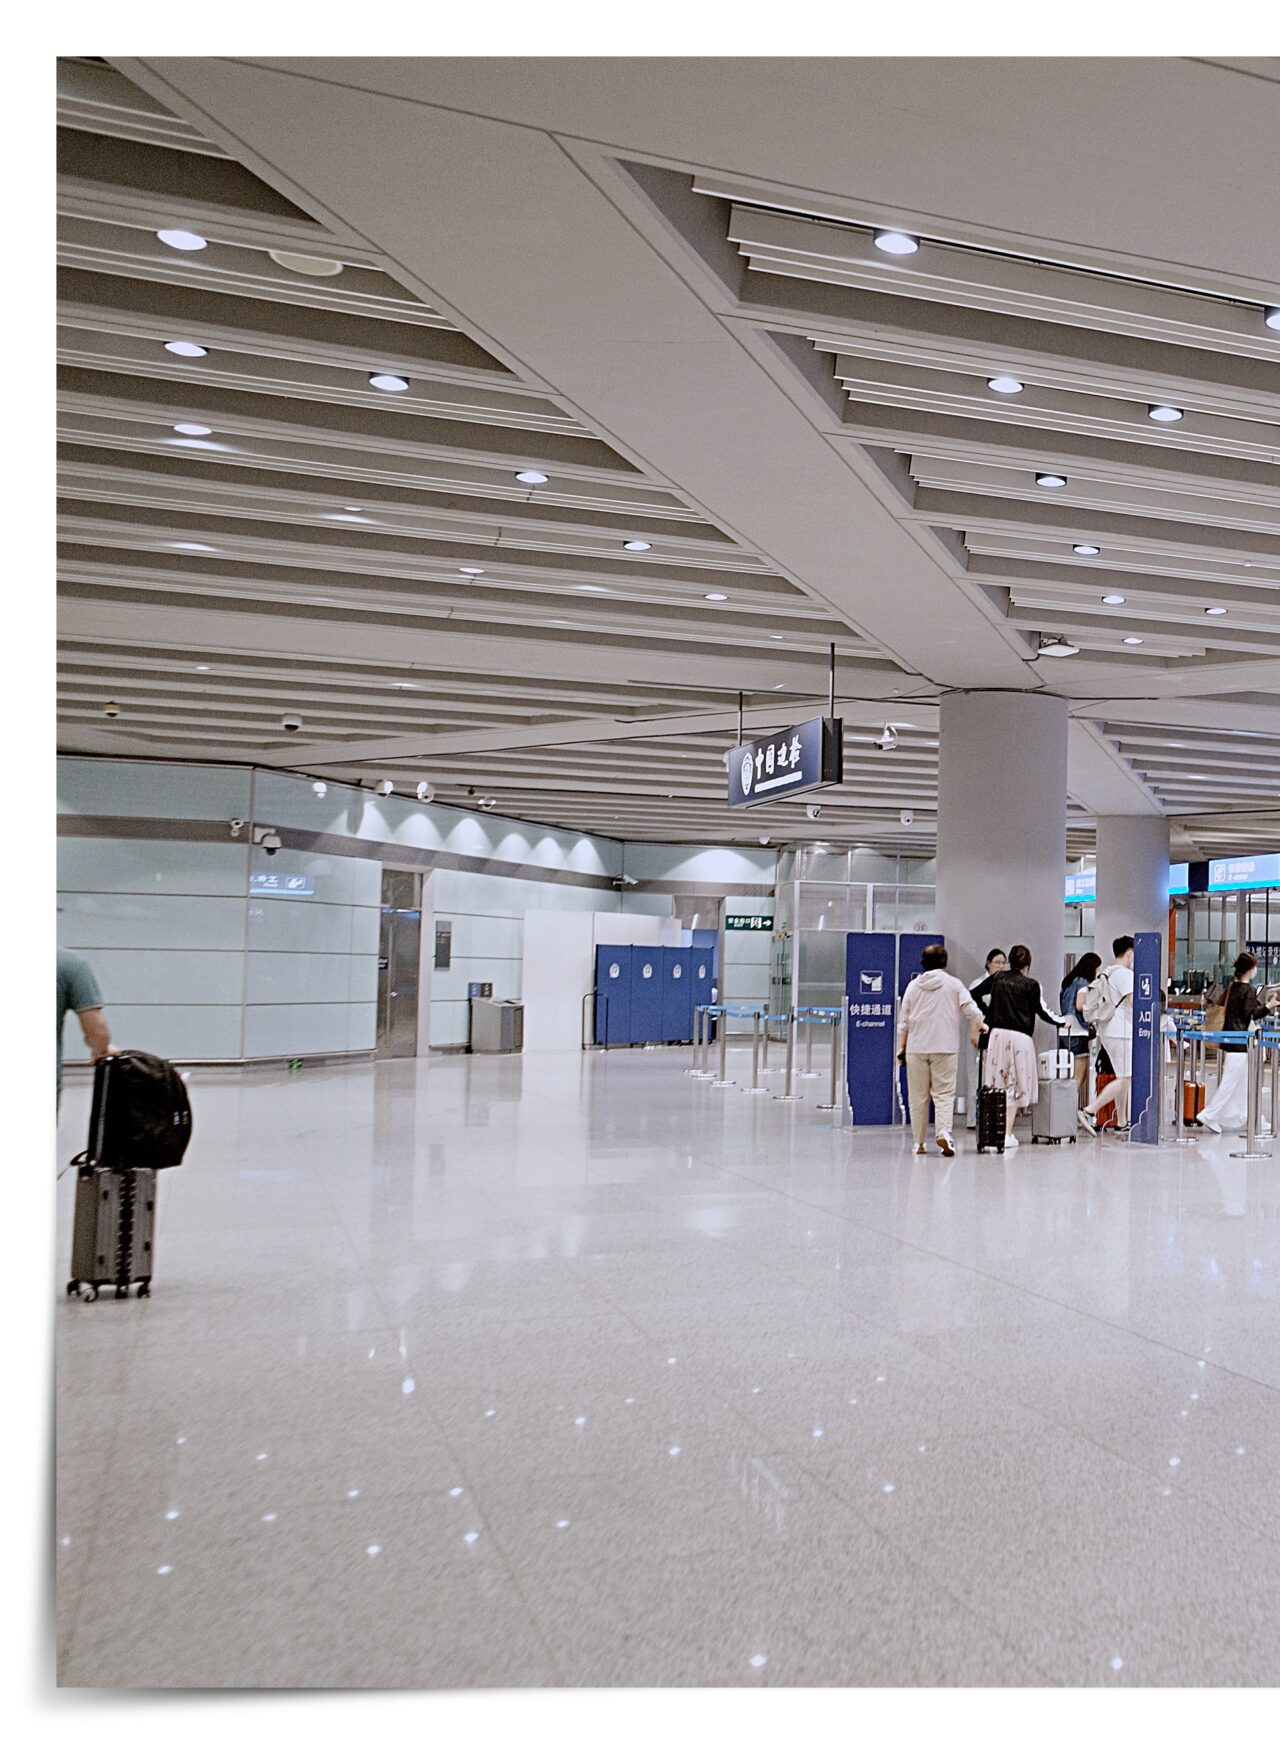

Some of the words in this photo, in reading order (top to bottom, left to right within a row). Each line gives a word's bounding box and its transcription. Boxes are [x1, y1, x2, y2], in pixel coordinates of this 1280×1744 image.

[849, 1003, 893, 1016] 快捷通道
[1138, 1011, 1152, 1023] 入口
[855, 1020, 886, 1028] E-channel
[1138, 1027, 1152, 1040] Entry
